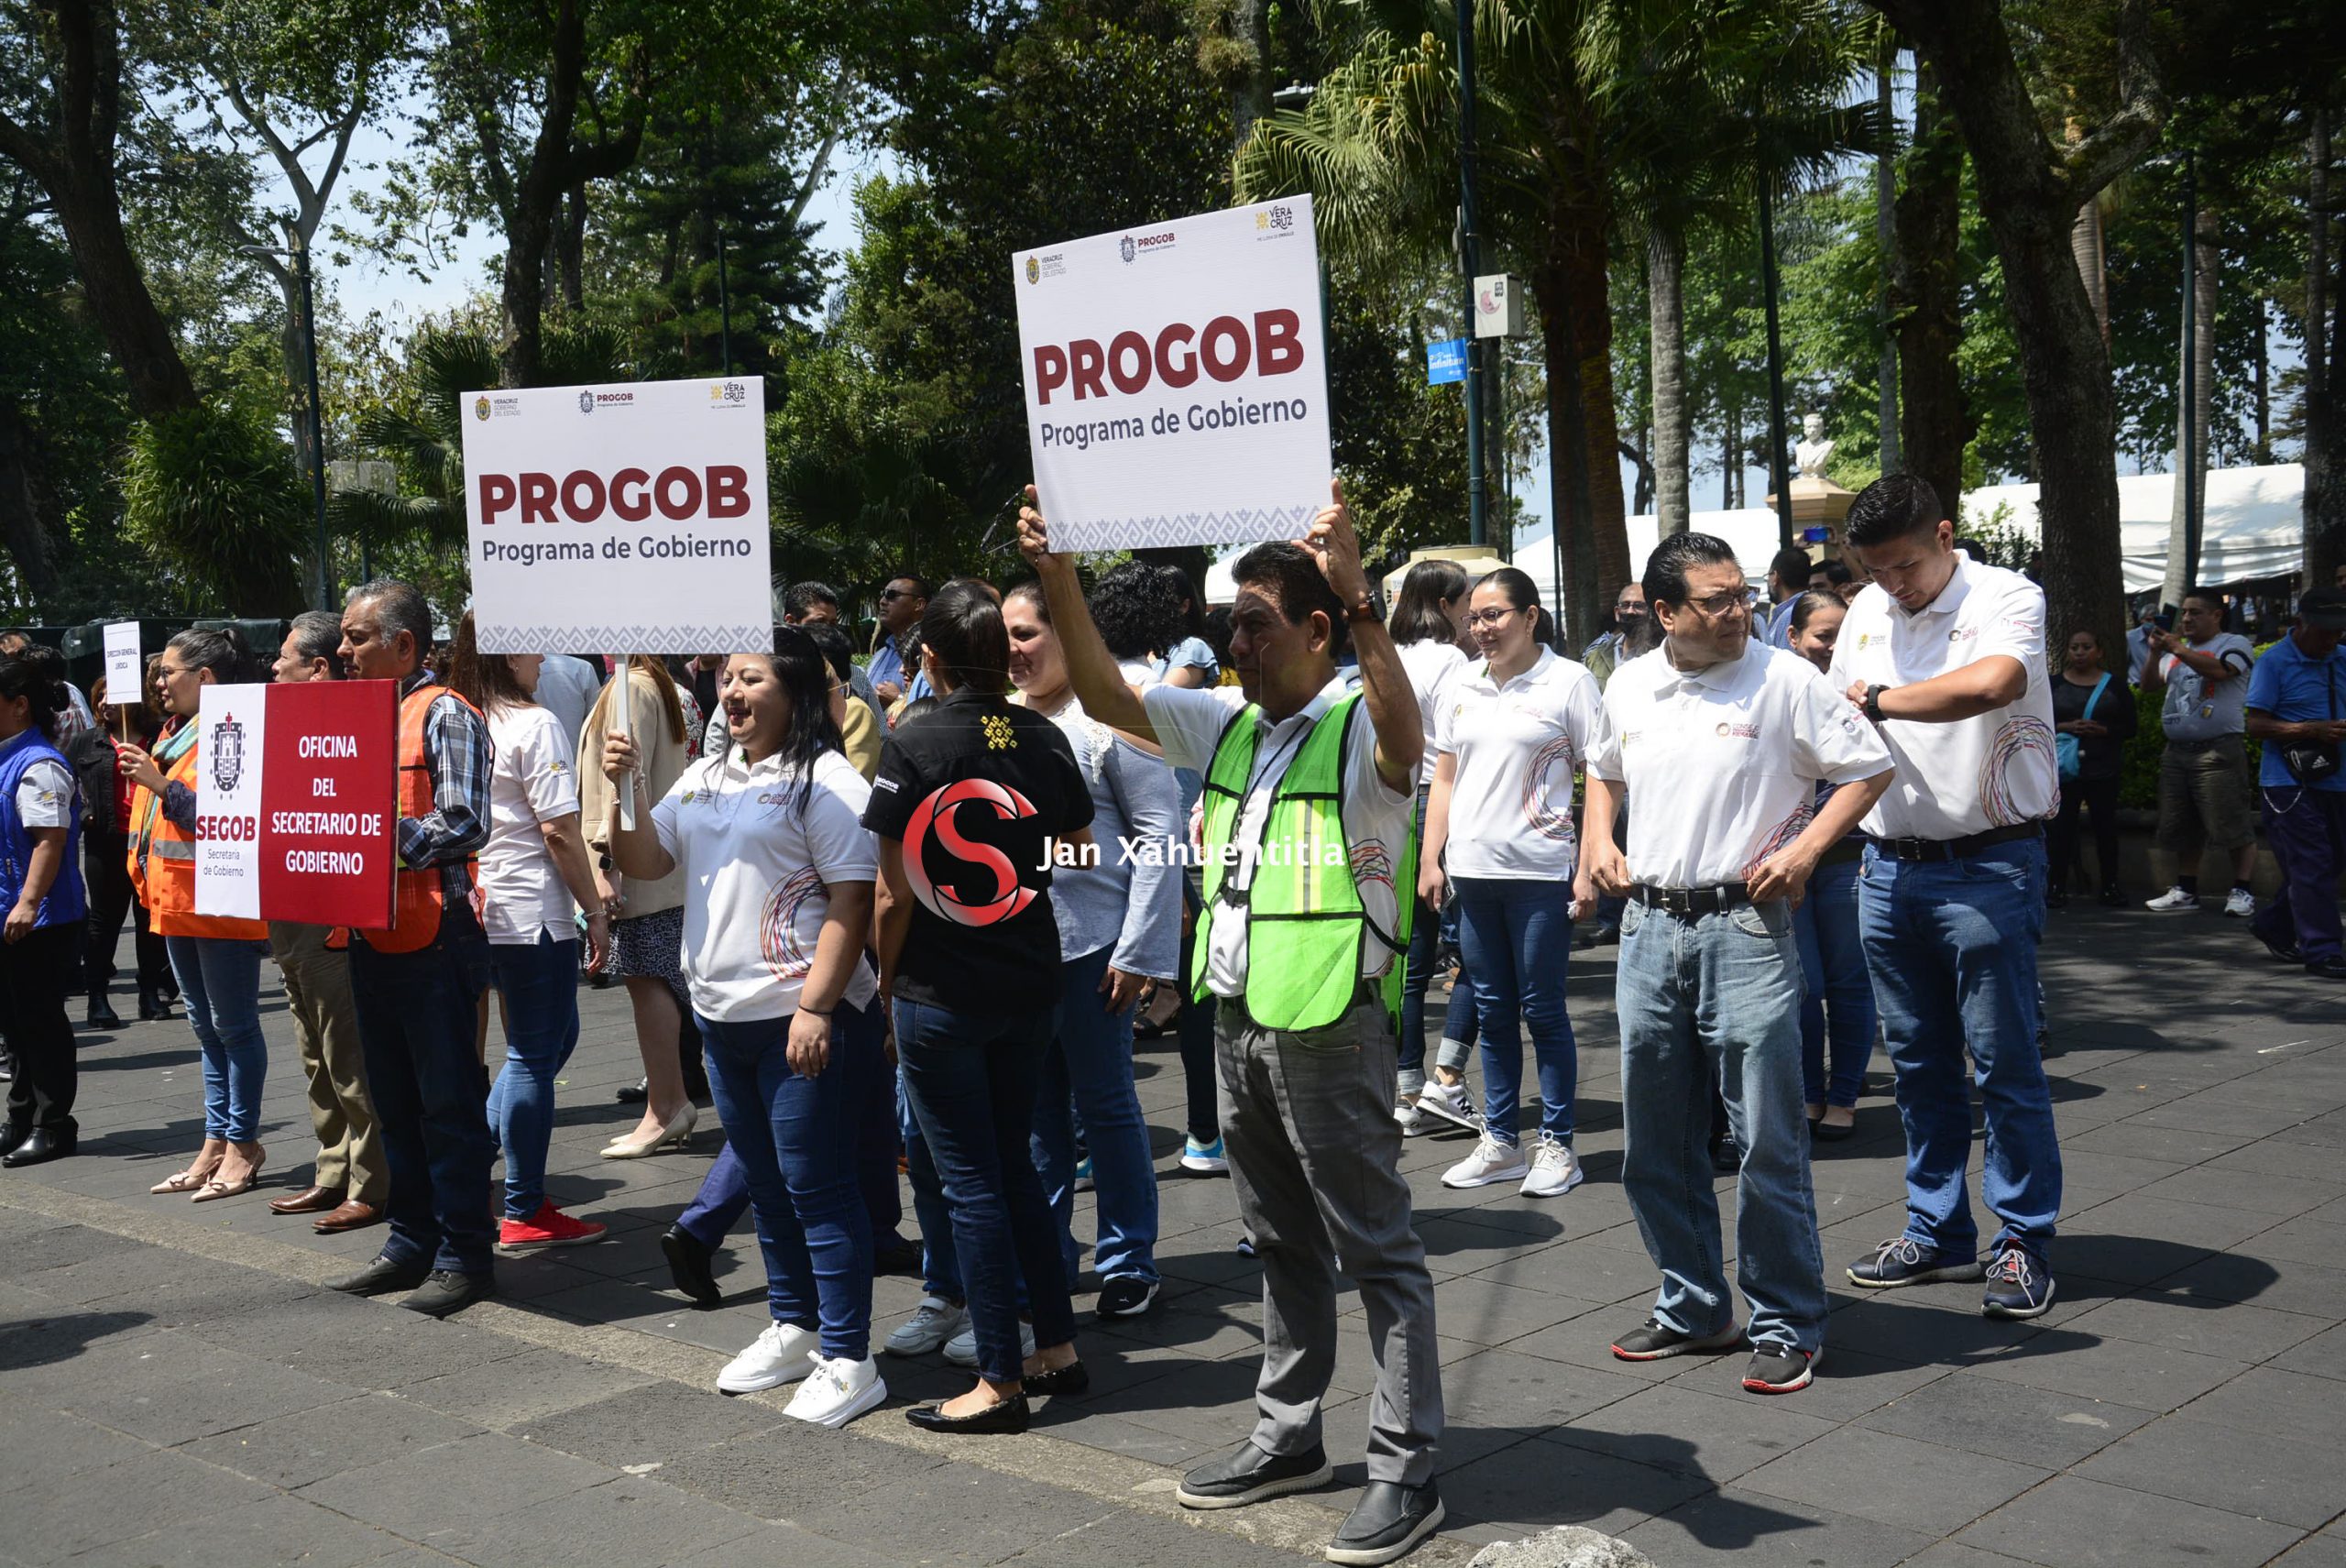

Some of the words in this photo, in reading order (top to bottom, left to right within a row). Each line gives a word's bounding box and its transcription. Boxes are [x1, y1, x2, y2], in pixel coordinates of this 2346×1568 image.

[1269, 205, 1292, 218] VERA
[1270, 216, 1293, 230] CRUZ
[1138, 233, 1175, 247] PROGOB
[1034, 308, 1304, 405] PROGOB
[724, 381, 745, 391] VERA
[597, 393, 633, 401] PROGOB
[724, 391, 745, 402] CRUZ
[1041, 416, 1145, 450] Programa
[1151, 408, 1180, 435] de
[1187, 396, 1307, 431] Gobierno
[478, 465, 751, 525] PROGOB
[482, 540, 595, 566] Programa
[601, 536, 631, 560] de
[638, 533, 751, 559] Gobierno
[299, 735, 357, 758] OFICINA
[312, 778, 337, 796] DEL
[196, 815, 256, 841] SEGOB
[271, 812, 357, 836] SECRETARIO
[361, 814, 382, 837] DE
[203, 865, 212, 876] de
[214, 864, 244, 877] Gobierno
[286, 850, 364, 875] GOBIERNO
